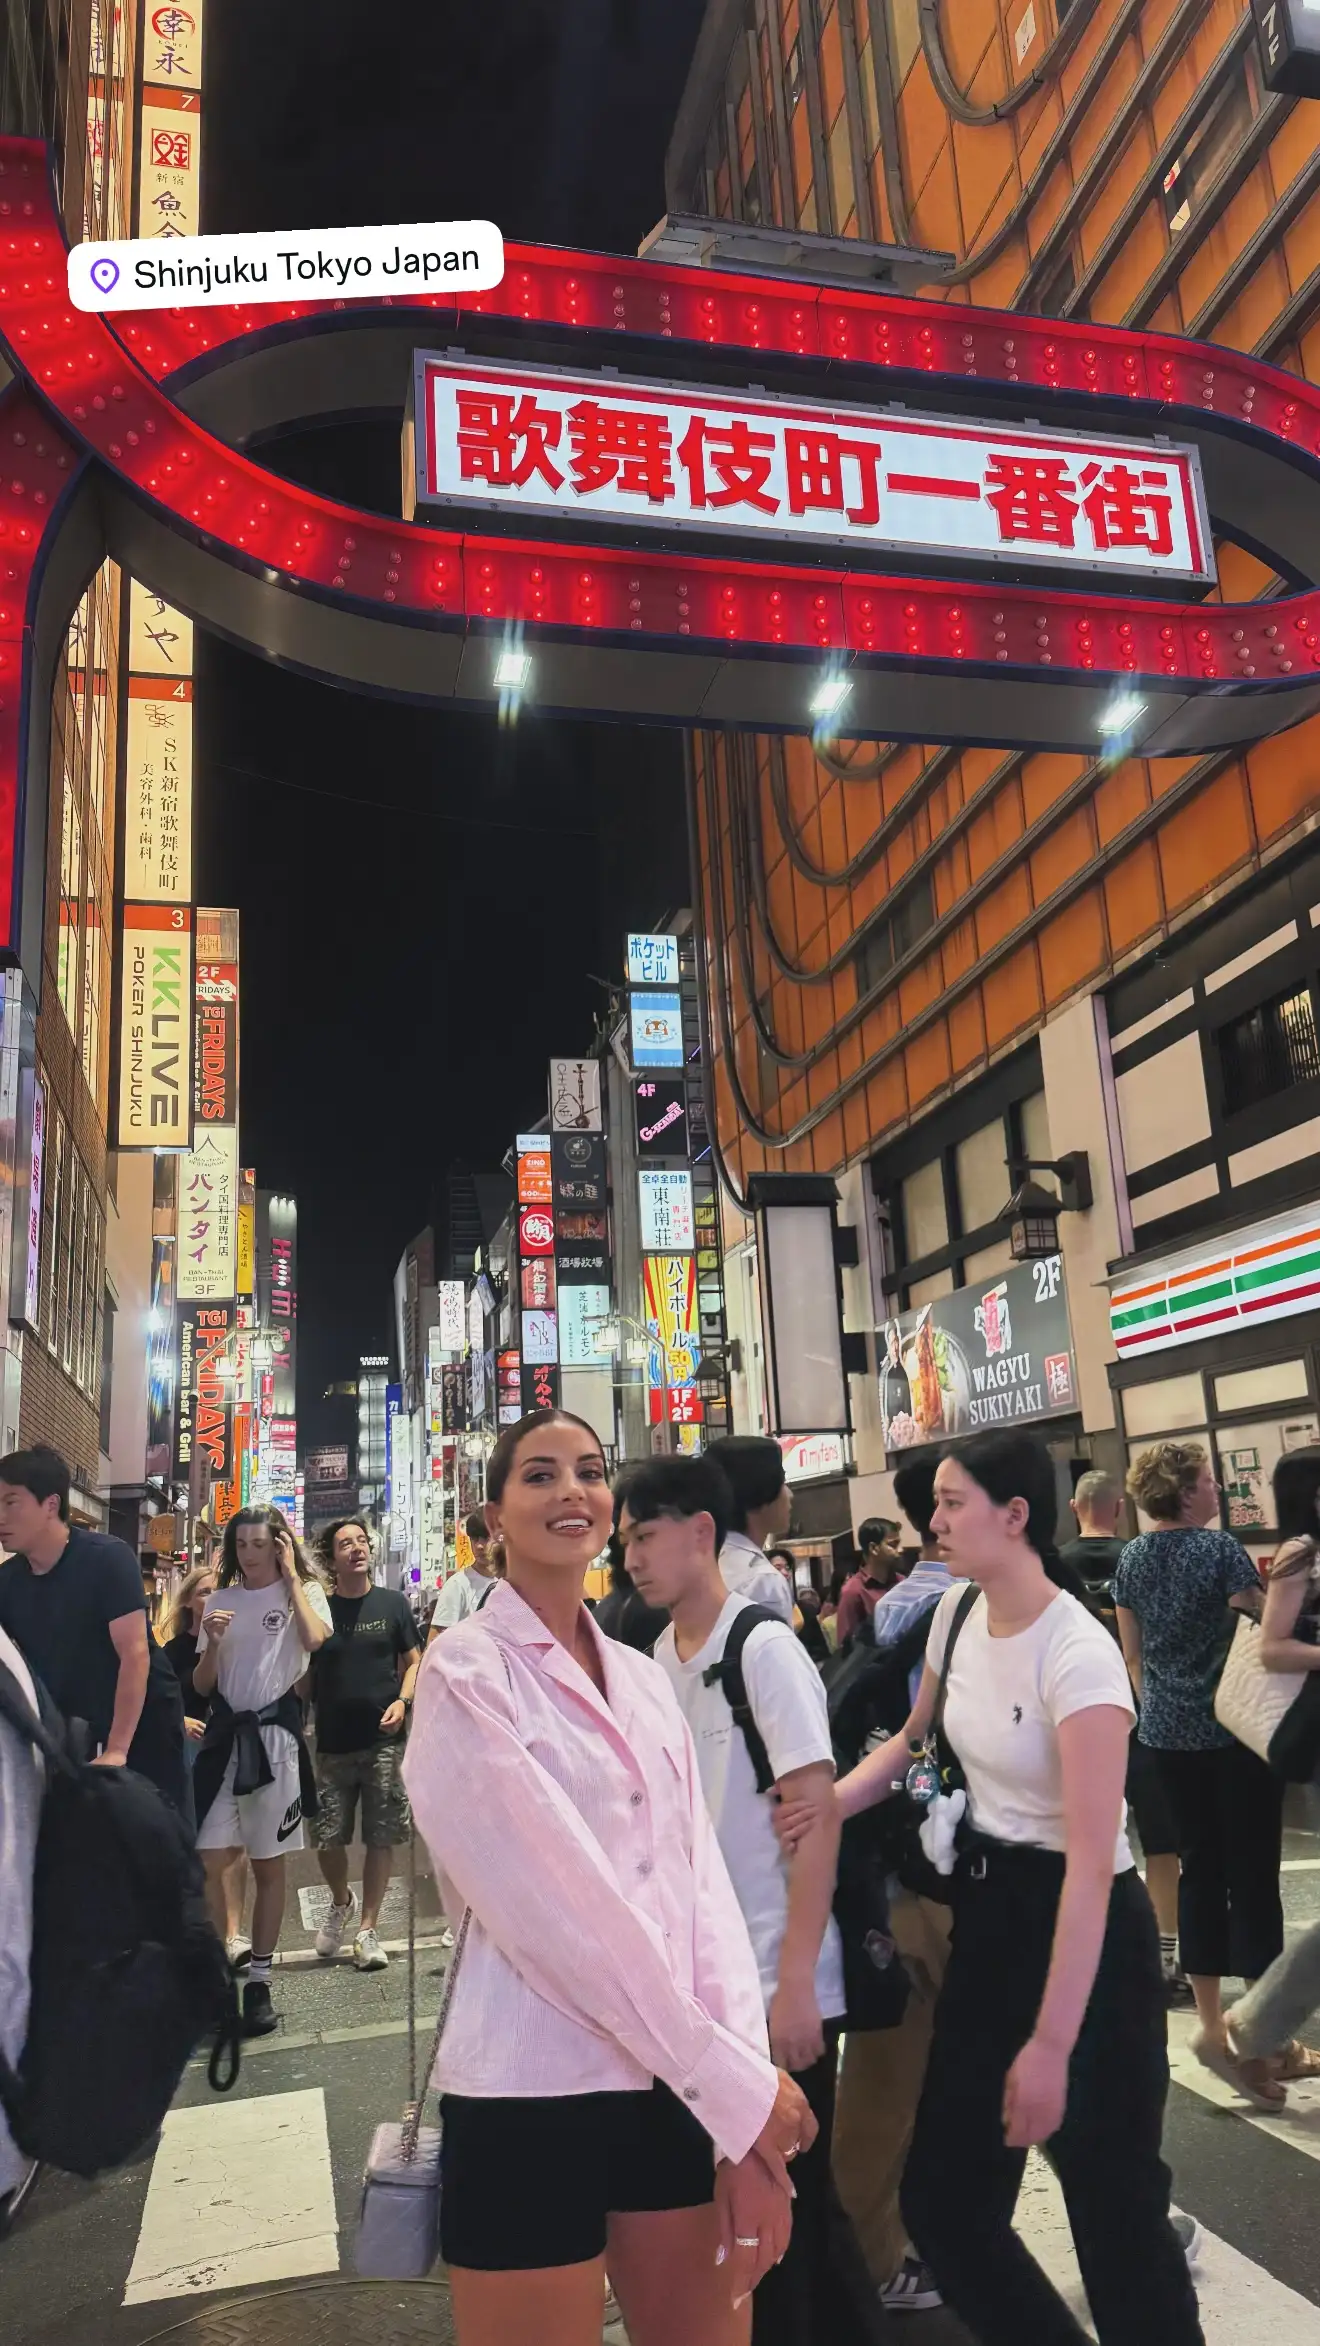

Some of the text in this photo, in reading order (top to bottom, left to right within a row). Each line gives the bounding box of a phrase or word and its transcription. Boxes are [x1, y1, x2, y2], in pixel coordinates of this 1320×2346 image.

[1261, 3, 1280, 65] 7F
[181, 94, 195, 109] 7
[455, 389, 1176, 556] 歌舞伎町一番街
[172, 681, 186, 698] 4
[158, 737, 180, 891] SK新宿歌舞伎町
[171, 910, 184, 928] 3
[630, 938, 675, 959] ポケット
[199, 965, 220, 977] 2F
[642, 961, 667, 981] ビル
[202, 1006, 226, 1019] TGI
[129, 946, 145, 1127] POKER SHINJUKU
[150, 947, 181, 1127] KKLIVE
[202, 1019, 226, 1119] FRIDAYS
[637, 1083, 656, 1097] 4F
[642, 1174, 688, 1184] 全卓全自動
[186, 1174, 214, 1264] バンタイ
[652, 1187, 672, 1246] 東南荘
[194, 1284, 216, 1295] 3F
[1032, 1255, 1061, 1303] 2F
[196, 1310, 228, 1326] TGI
[668, 1261, 688, 1348] ハイボール
[181, 1321, 194, 1387] American
[972, 1352, 1031, 1393] WAGYU
[1049, 1360, 1070, 1400] 極
[195, 1328, 226, 1470] FRIDAYS
[672, 1389, 693, 1404] 1F
[969, 1383, 1044, 1425] SUKIYAKI
[180, 1417, 192, 1429] &
[672, 1407, 693, 1422] 2F
[179, 1433, 192, 1463] Grill
